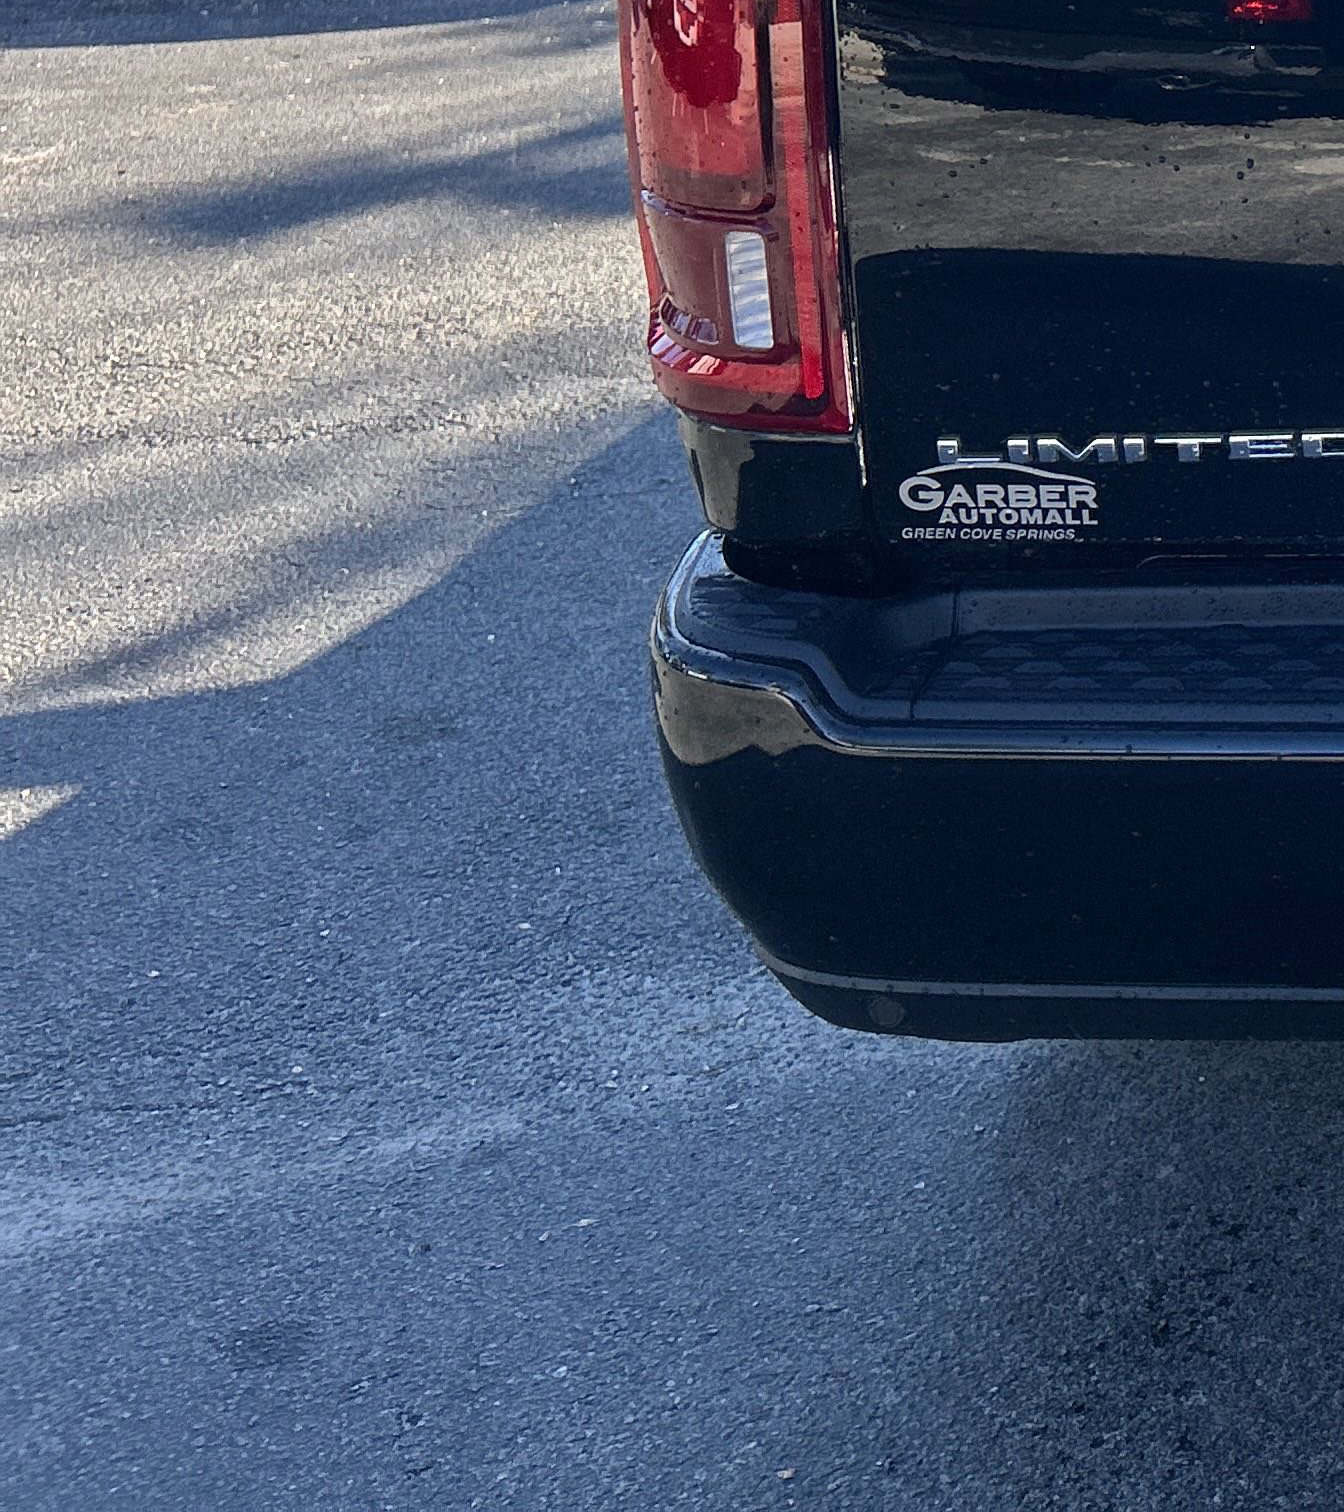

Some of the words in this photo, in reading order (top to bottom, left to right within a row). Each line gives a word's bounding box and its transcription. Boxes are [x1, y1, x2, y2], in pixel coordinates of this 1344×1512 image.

[899, 475, 1099, 511] GARBER
[938, 508, 1099, 525] AUTOMALL
[901, 527, 956, 539] GREEN
[960, 528, 1003, 540] COVE
[1005, 529, 1076, 541] SPRINGS
